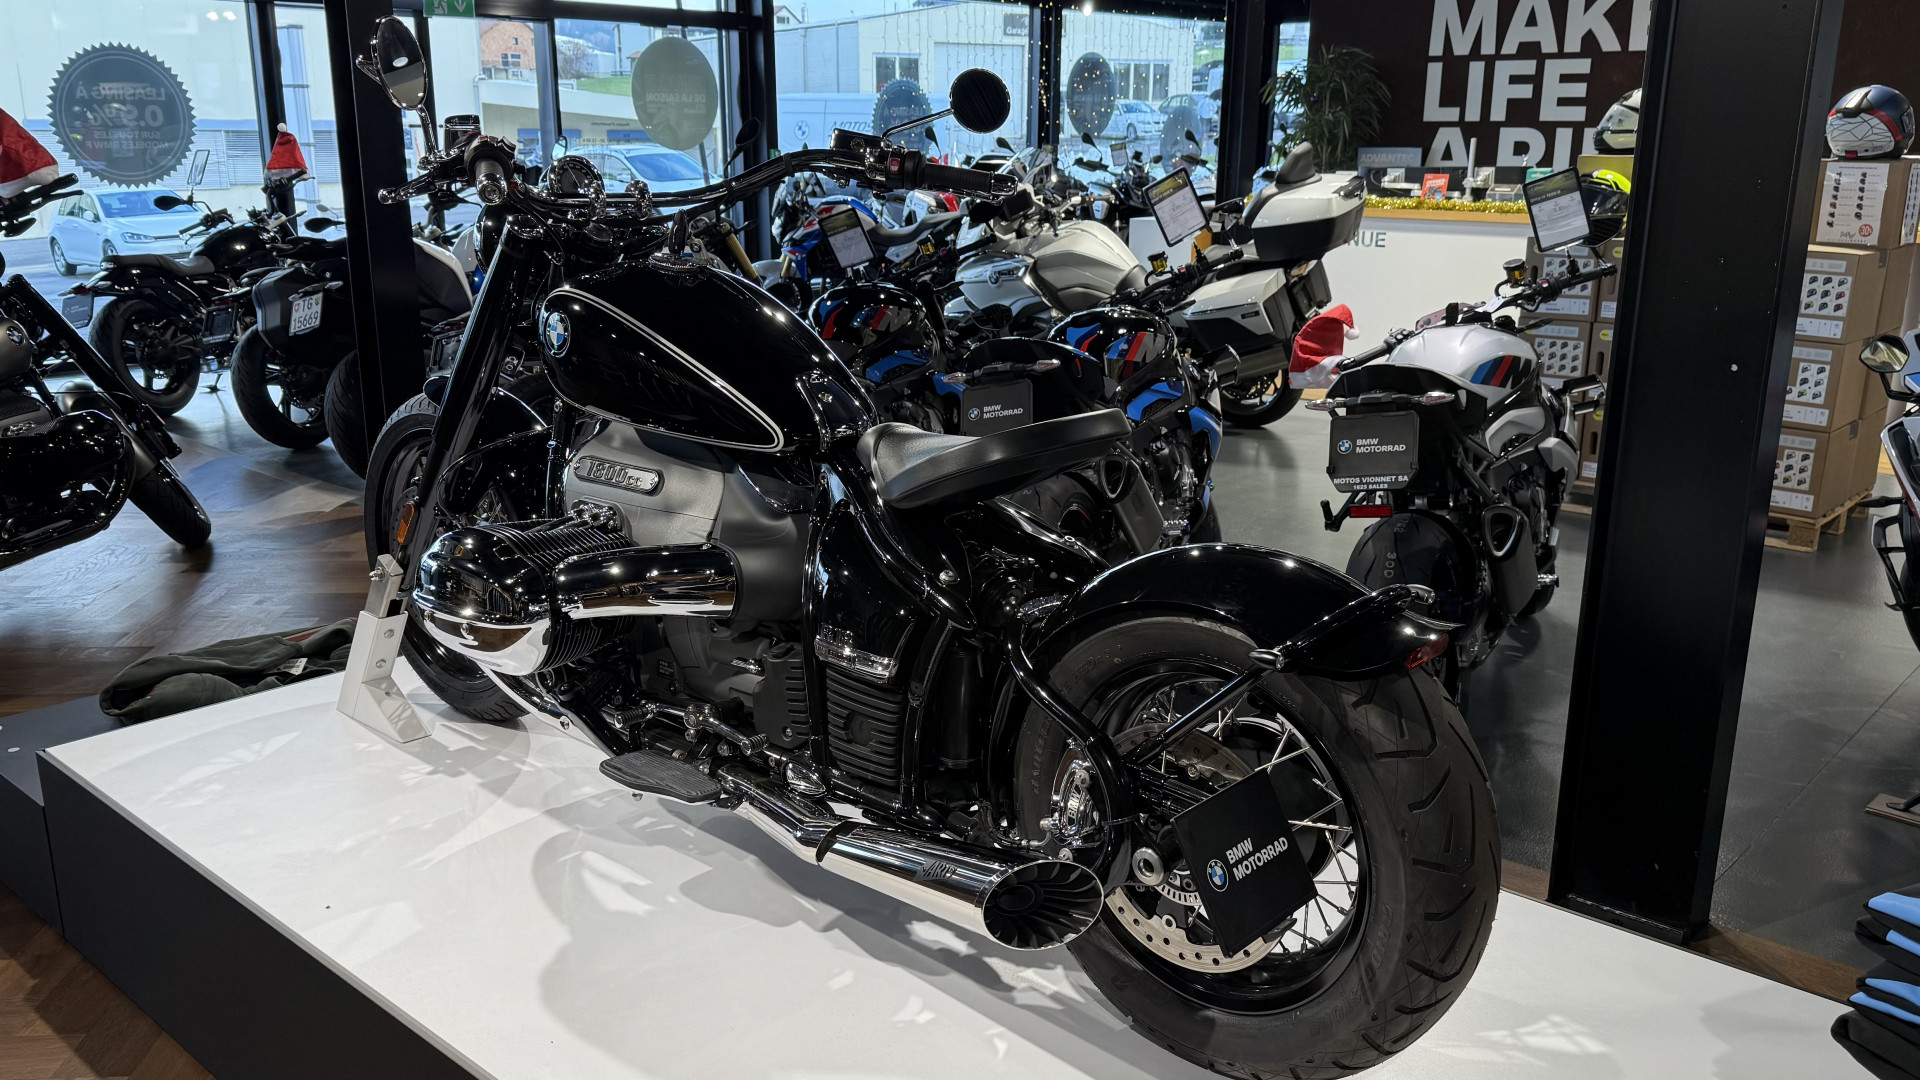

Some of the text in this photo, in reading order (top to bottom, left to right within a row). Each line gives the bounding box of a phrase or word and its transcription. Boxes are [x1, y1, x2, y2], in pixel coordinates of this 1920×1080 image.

[1423, 58, 1592, 122] LIFE
[302, 297, 314, 312] TG
[292, 310, 319, 331] 15669
[983, 404, 1002, 413] BMW
[983, 407, 1023, 419] MOTORRAD
[1355, 444, 1407, 454] MOTORRAD
[1356, 438, 1379, 446] BMW
[586, 460, 642, 488] 1800cc
[1333, 477, 1361, 485] MOTOS
[1361, 475, 1397, 484] VIONNET
[1068, 790, 1081, 817] BMW
[1225, 837, 1254, 865] BMW
[1232, 836, 1289, 882] MOTORRAD
